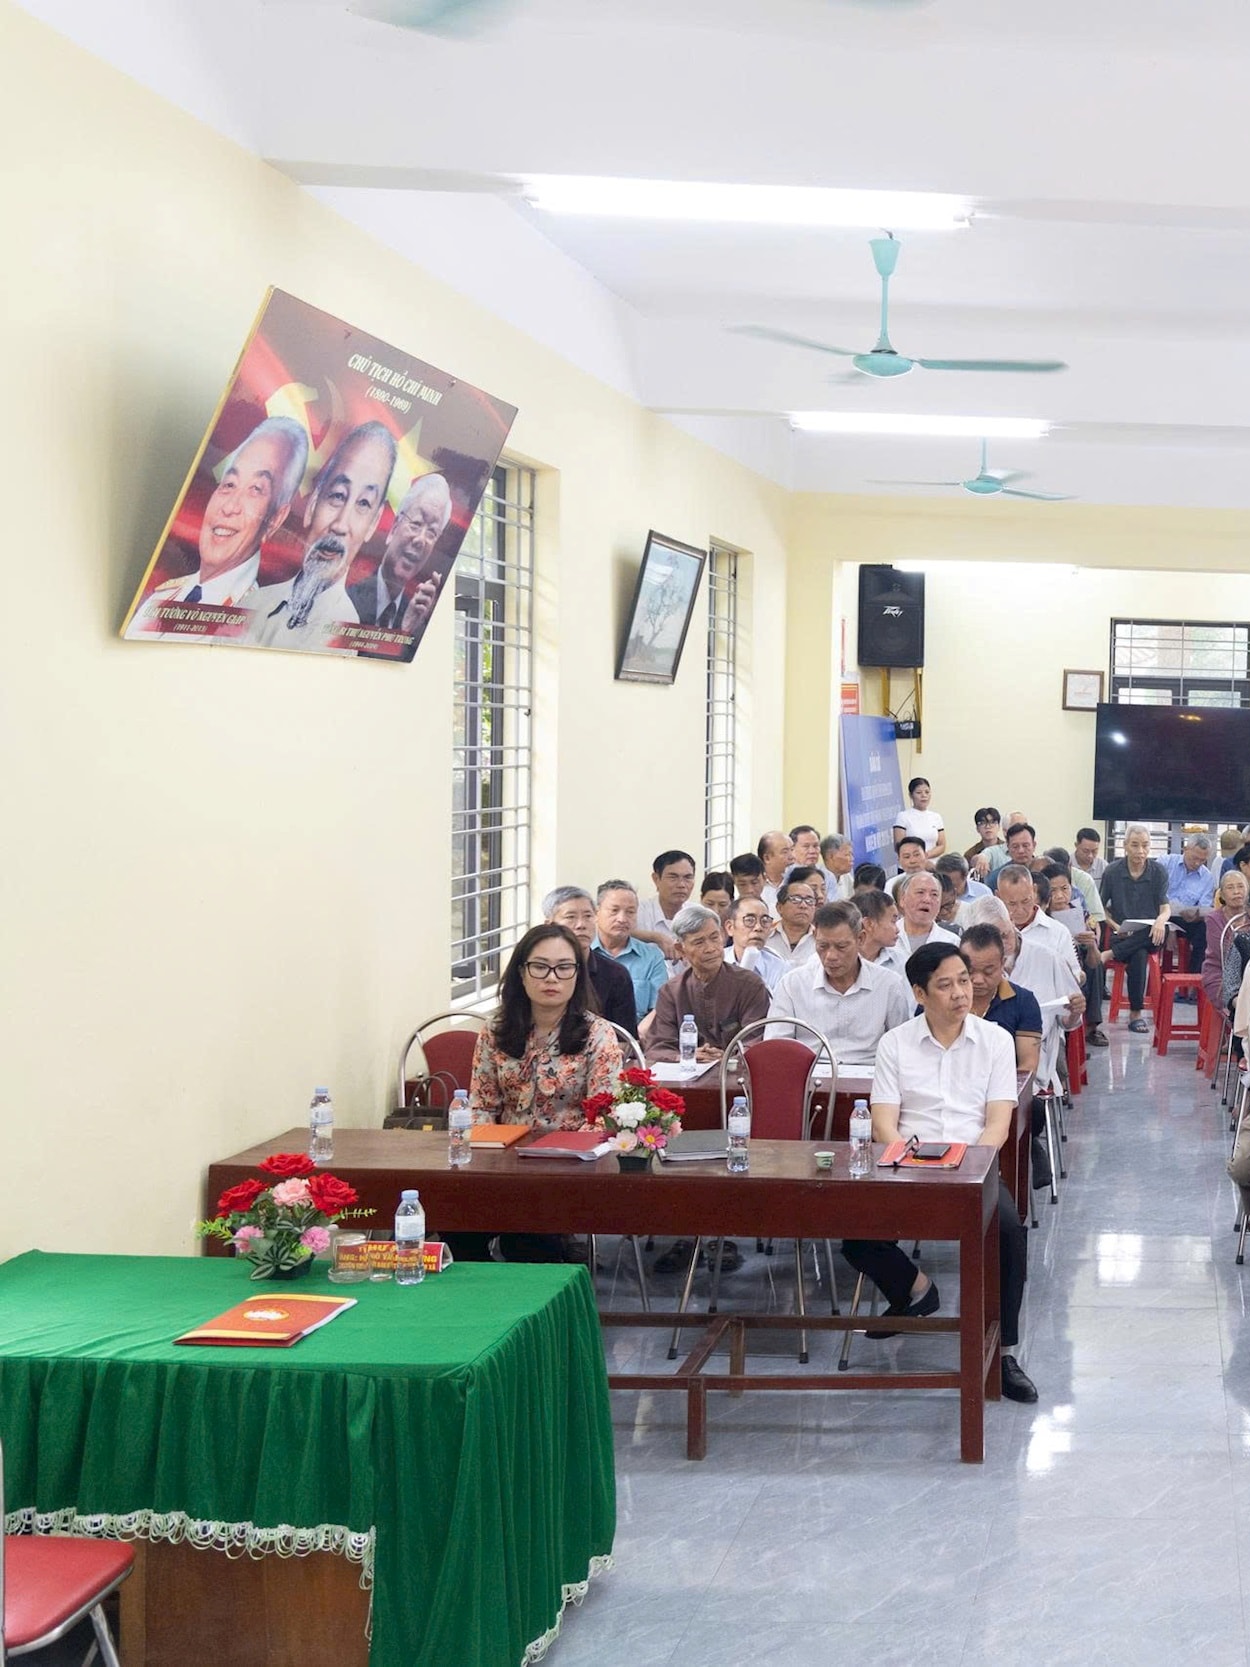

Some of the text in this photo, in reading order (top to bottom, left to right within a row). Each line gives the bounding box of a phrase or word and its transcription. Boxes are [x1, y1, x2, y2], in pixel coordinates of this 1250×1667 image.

[348, 353, 443, 406] CHỦ TỊCH HỒ CHÍ MINH
[364, 385, 413, 414] (1890-1969)
